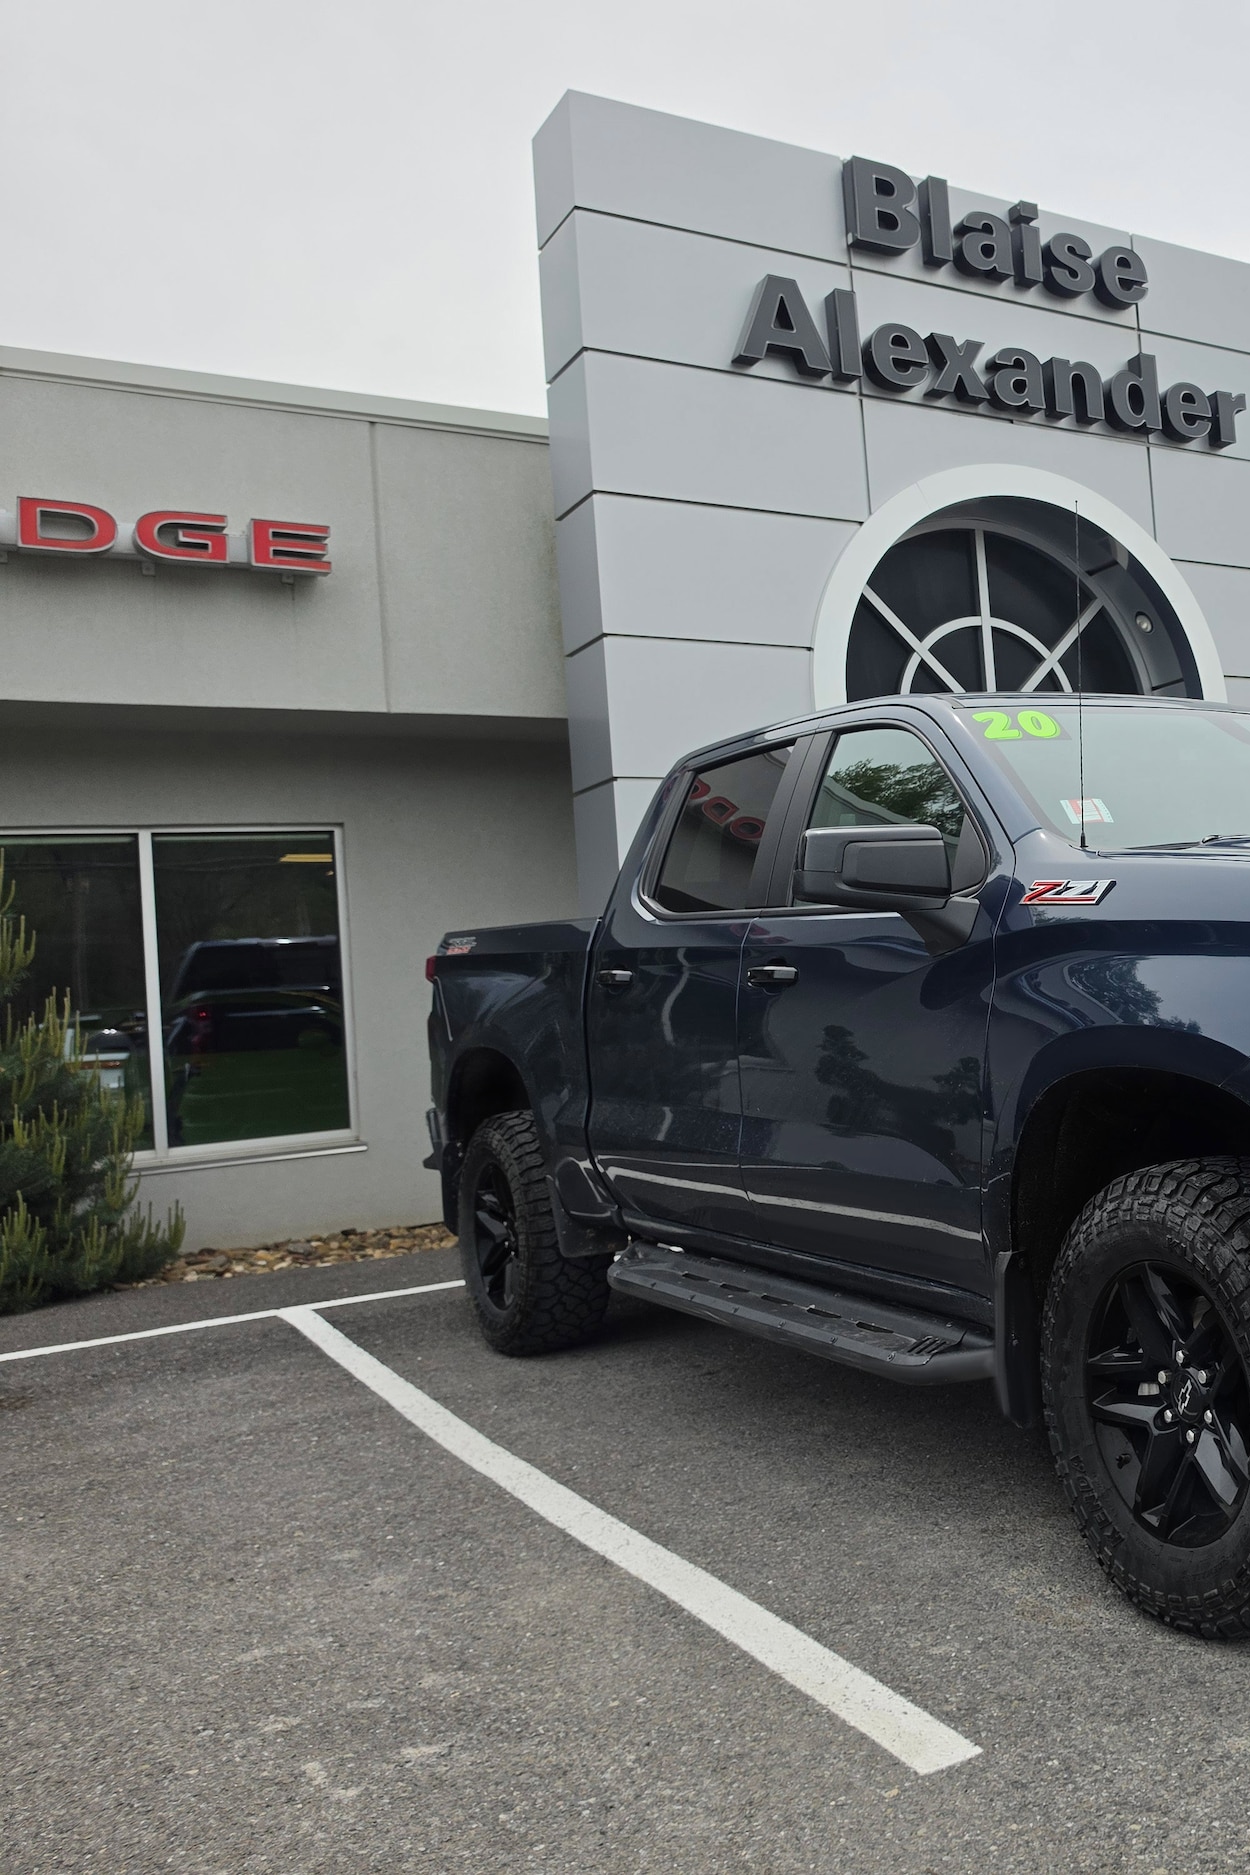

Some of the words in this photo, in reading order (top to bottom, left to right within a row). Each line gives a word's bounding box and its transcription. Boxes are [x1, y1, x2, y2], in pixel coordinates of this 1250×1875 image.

[842, 156, 1149, 310] Blaise
[732, 274, 1246, 449] Alexander
[17, 496, 332, 576] DGE
[972, 710, 1061, 740] 20
[1069, 1454, 1126, 1548] KENDA
